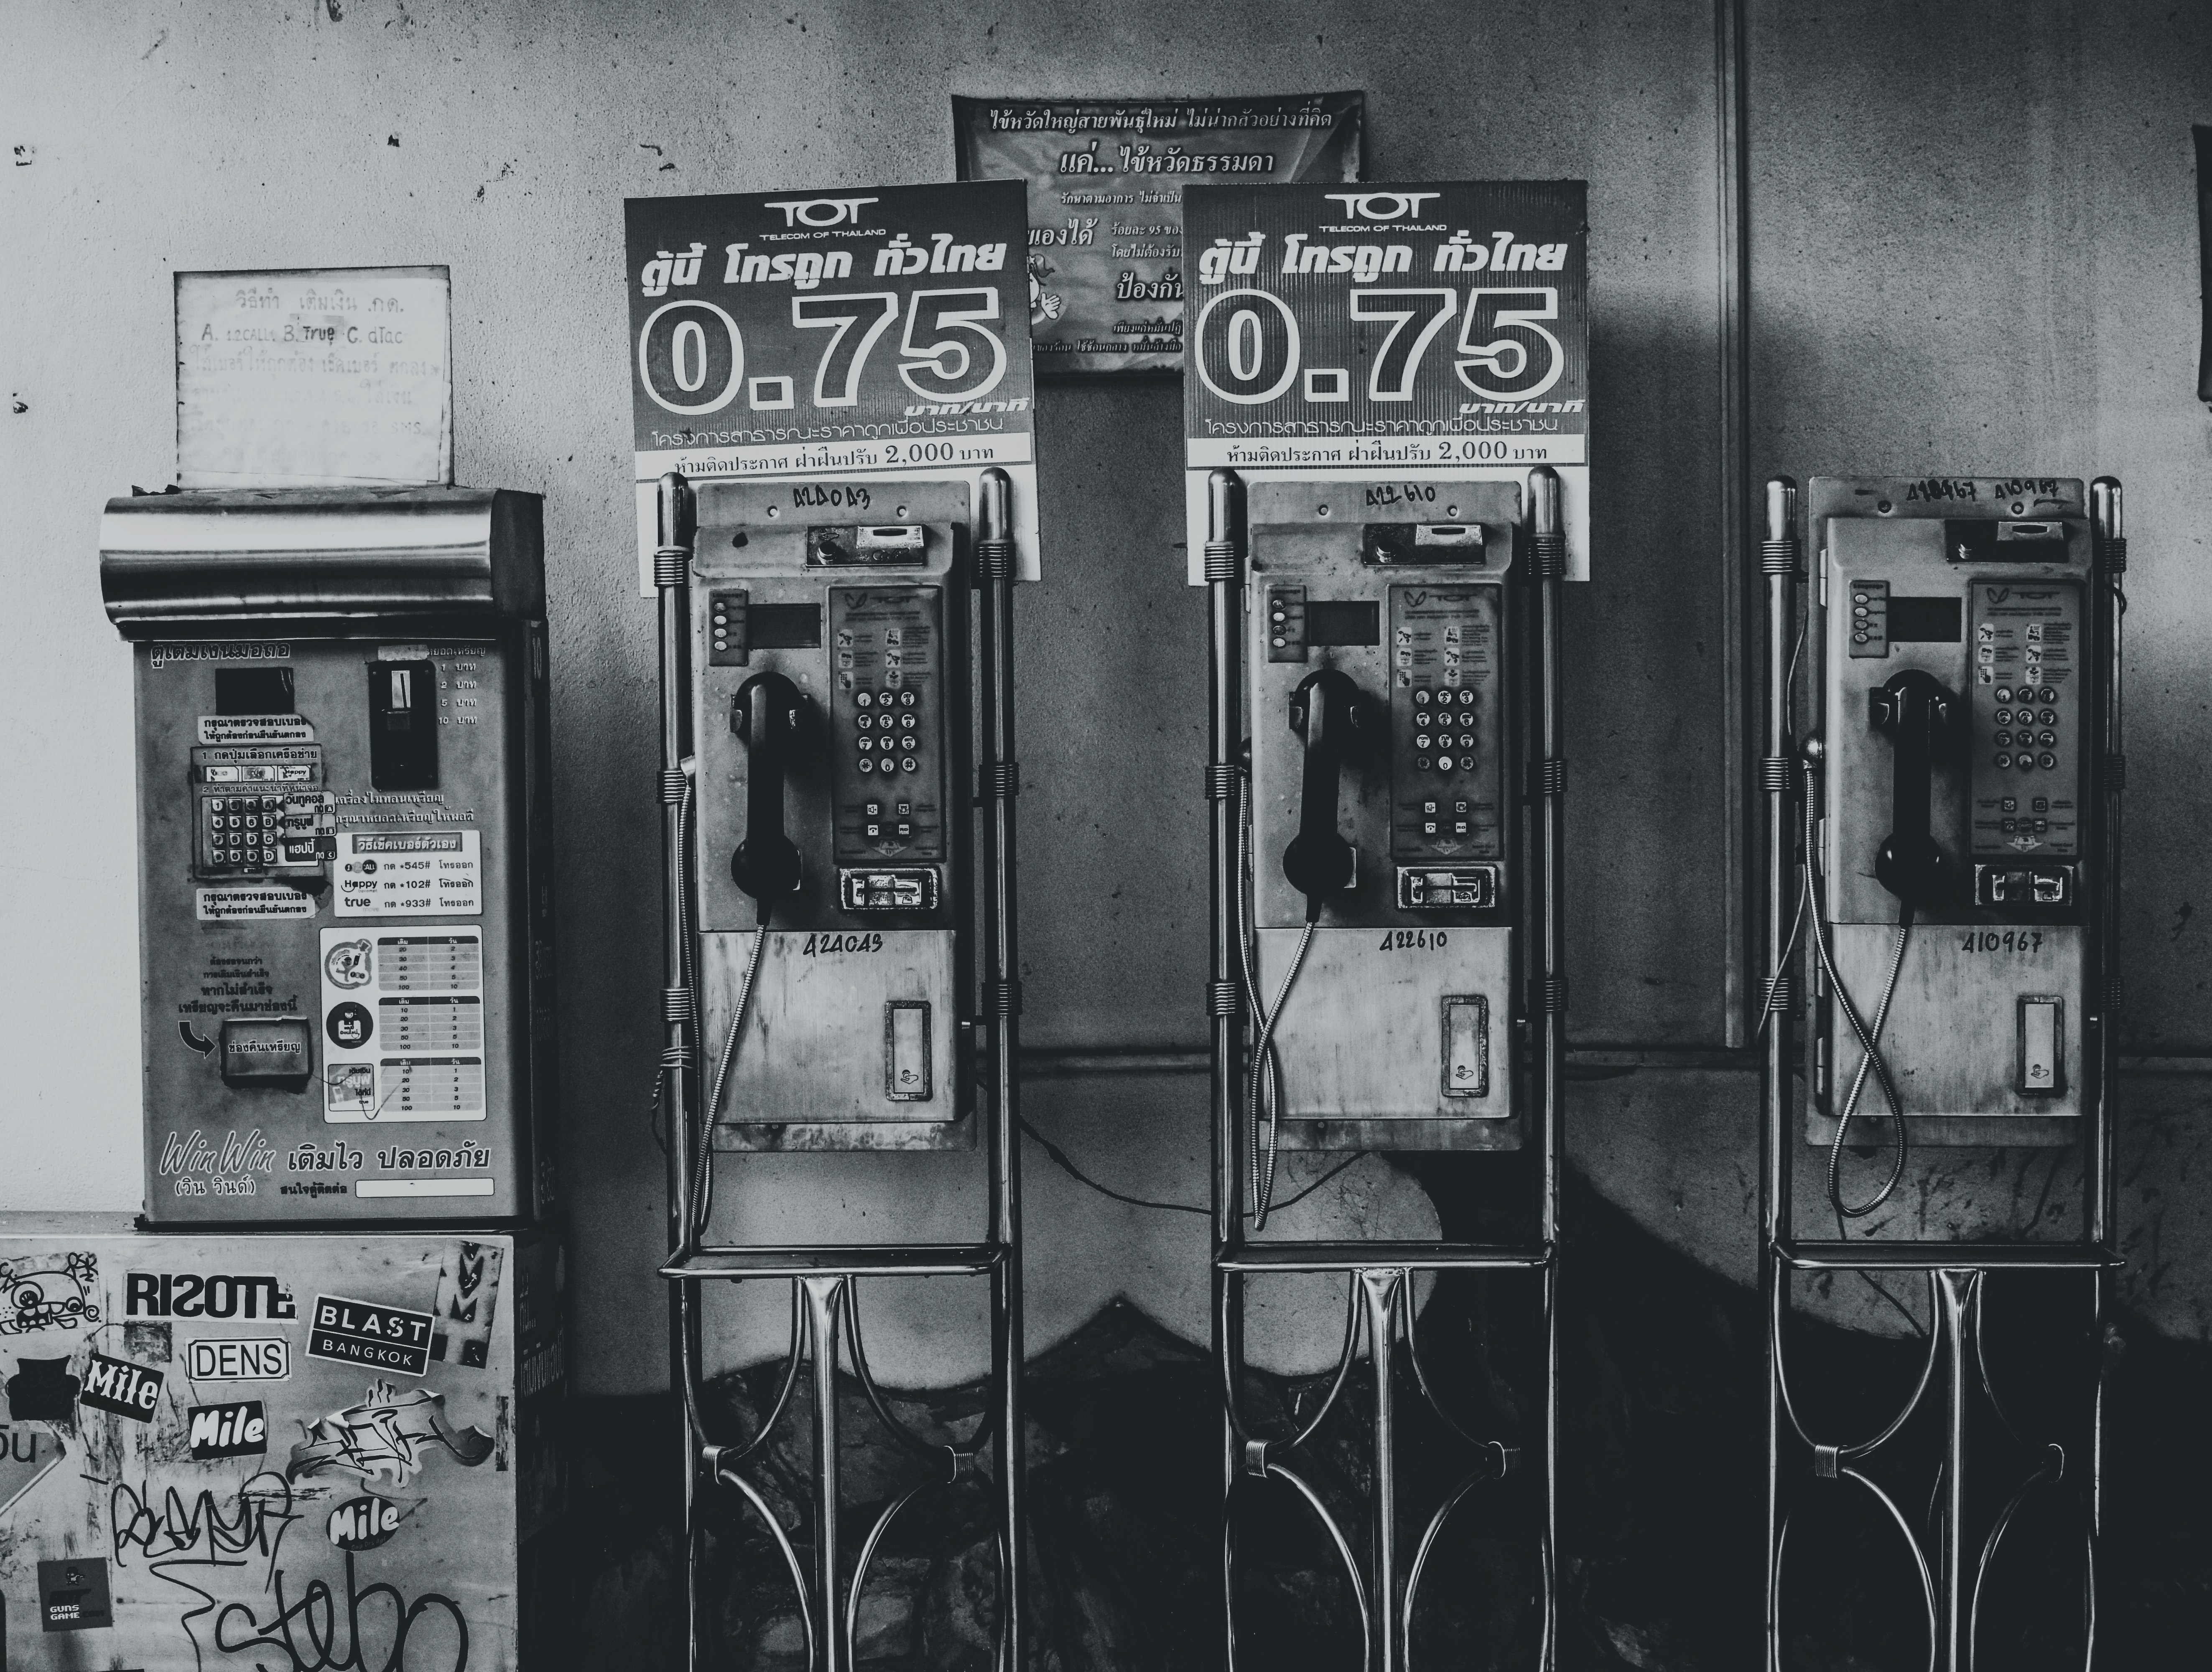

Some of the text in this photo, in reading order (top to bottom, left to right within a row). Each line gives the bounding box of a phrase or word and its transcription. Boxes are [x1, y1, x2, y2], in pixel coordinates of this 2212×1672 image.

[1060, 141, 1274, 173] แค่... ไข้หวัดธรรมดา
[1061, 192, 1134, 204] รักษาตามอาการ
[1324, 192, 1440, 220] TOT
[765, 197, 879, 228] TOT
[832, 228, 886, 238] THAILAND
[1111, 222, 1146, 235] ร้อยละ
[1149, 226, 1161, 234] 95
[641, 233, 1007, 296] ตู้นี้ โทรถูก ทั่วไทย
[1198, 230, 1569, 285] ตู้นี้ โทรถูก ทั่วไทย
[639, 286, 1008, 416] 0.75
[1195, 287, 1565, 405] 0.75
[905, 397, 1030, 417] บาท/นาที
[1458, 399, 1586, 414] บาท/นาที
[674, 441, 995, 475] ห้ามติดประกาศ ฝ่าฝืนปรับ 2,000 บาท
[1227, 440, 1548, 464] ห้ามติดประกาศ ฝ่าฝืนปรับ 2,000 บาท
[456, 681, 477, 689] บาท
[439, 859, 474, 869] โทรออก
[344, 880, 377, 889] Happy
[439, 878, 474, 888] โทรออก
[344, 897, 371, 907] true
[439, 897, 474, 907] โทรออก
[1962, 930, 2043, 953] 410967
[228, 1040, 301, 1054] ช่องคืนเหรียญ
[288, 1140, 491, 1172] เติมไว ปลอดภัย
[319, 1305, 427, 1341] BLAST
[196, 1344, 282, 1377] DENS
[323, 1339, 413, 1366] BANGKOK
[84, 1359, 159, 1409] Mile
[190, 1405, 264, 1448] Mile
[330, 1498, 399, 1544] Mile
[50, 1604, 79, 1613] GUNS
[50, 1611, 80, 1620] GAME
